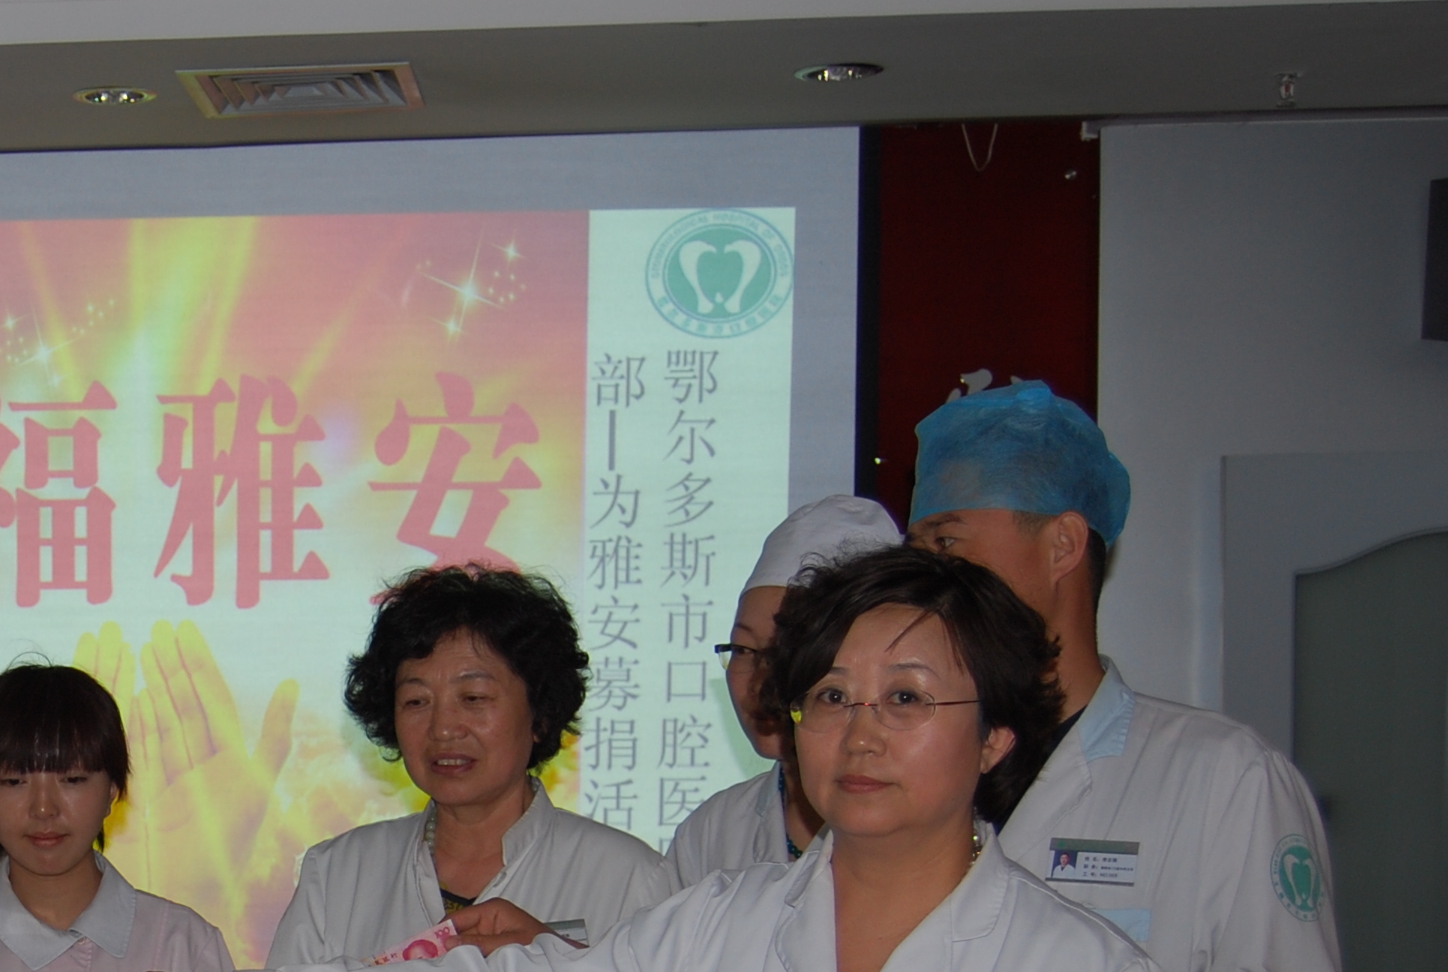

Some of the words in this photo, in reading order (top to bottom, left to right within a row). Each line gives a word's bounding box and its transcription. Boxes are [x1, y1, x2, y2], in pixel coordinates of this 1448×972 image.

[657, 348, 720, 856] 鄂尔多斯市口腔医
